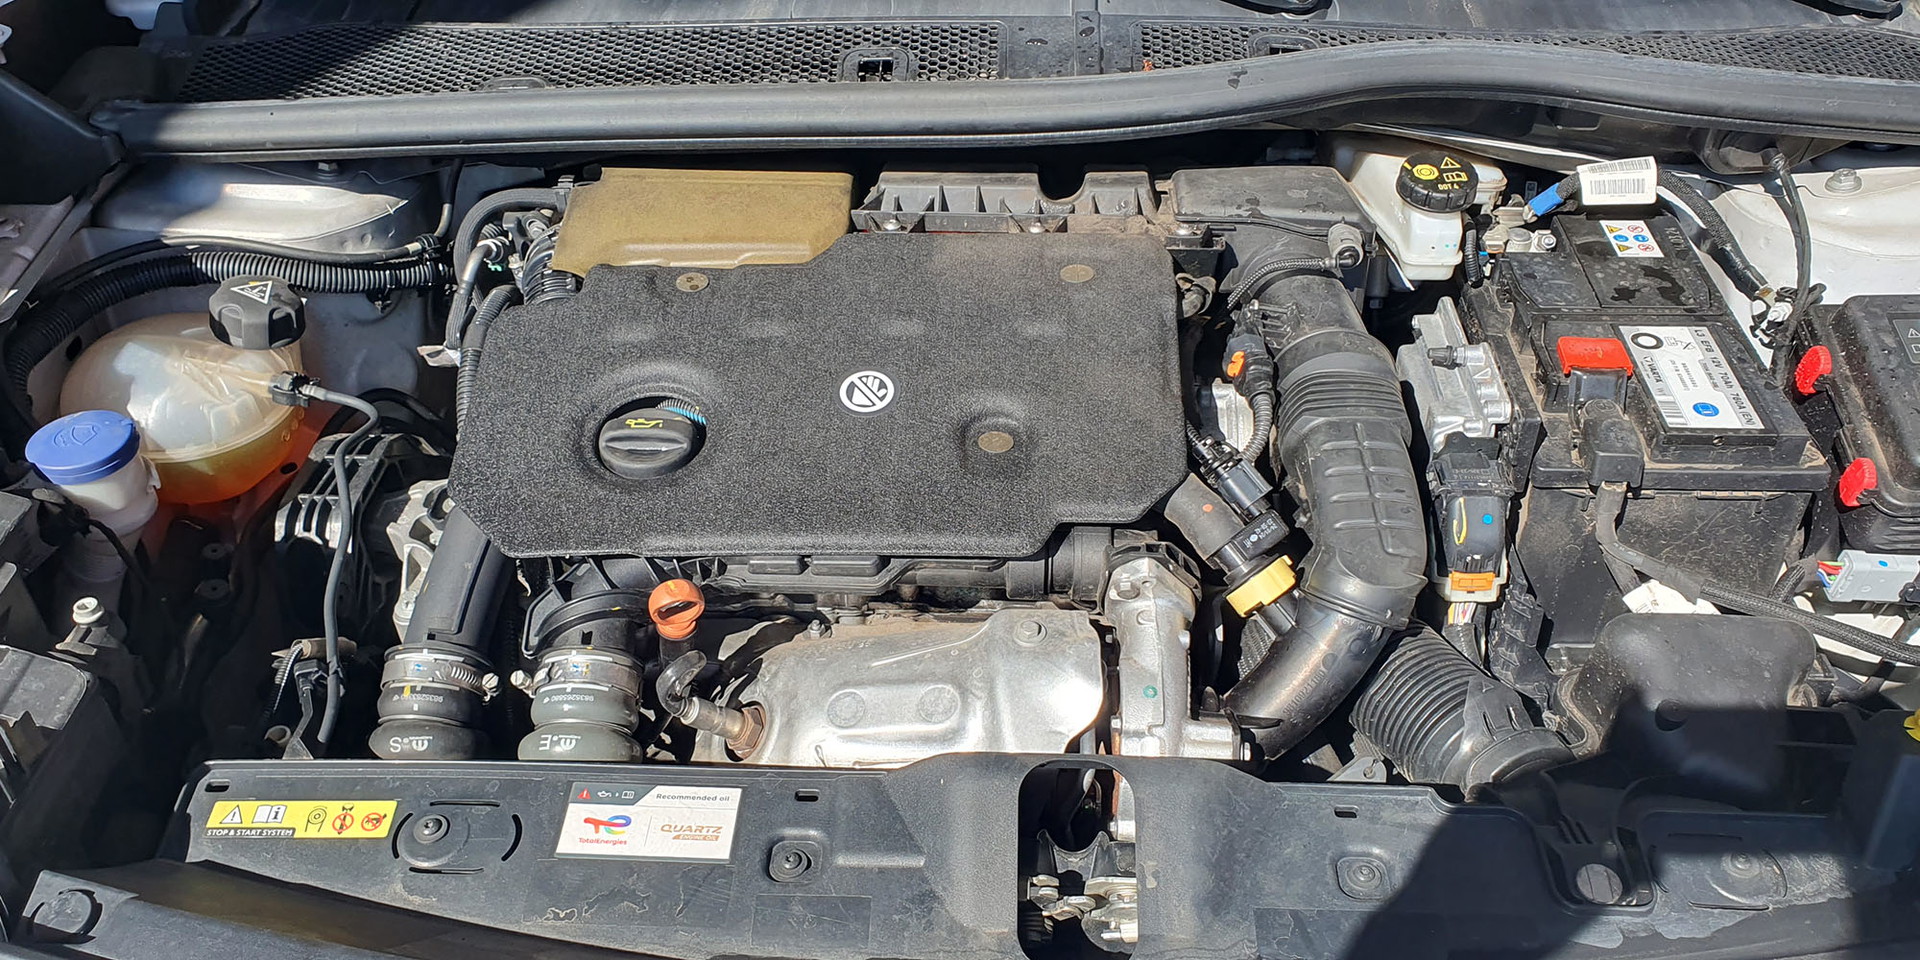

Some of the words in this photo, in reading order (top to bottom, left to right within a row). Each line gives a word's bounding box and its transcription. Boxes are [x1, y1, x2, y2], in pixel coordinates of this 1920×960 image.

[1700, 340, 1715, 352] EFB
[1709, 356, 1724, 369] 12V
[1718, 372, 1735, 389] 70Ah
[206, 828, 228, 836] STOP
[236, 828, 261, 836] START
[262, 828, 294, 836] SYSTEM
[660, 824, 723, 834] QUARTZ
[579, 837, 627, 846] TotalEnergies
